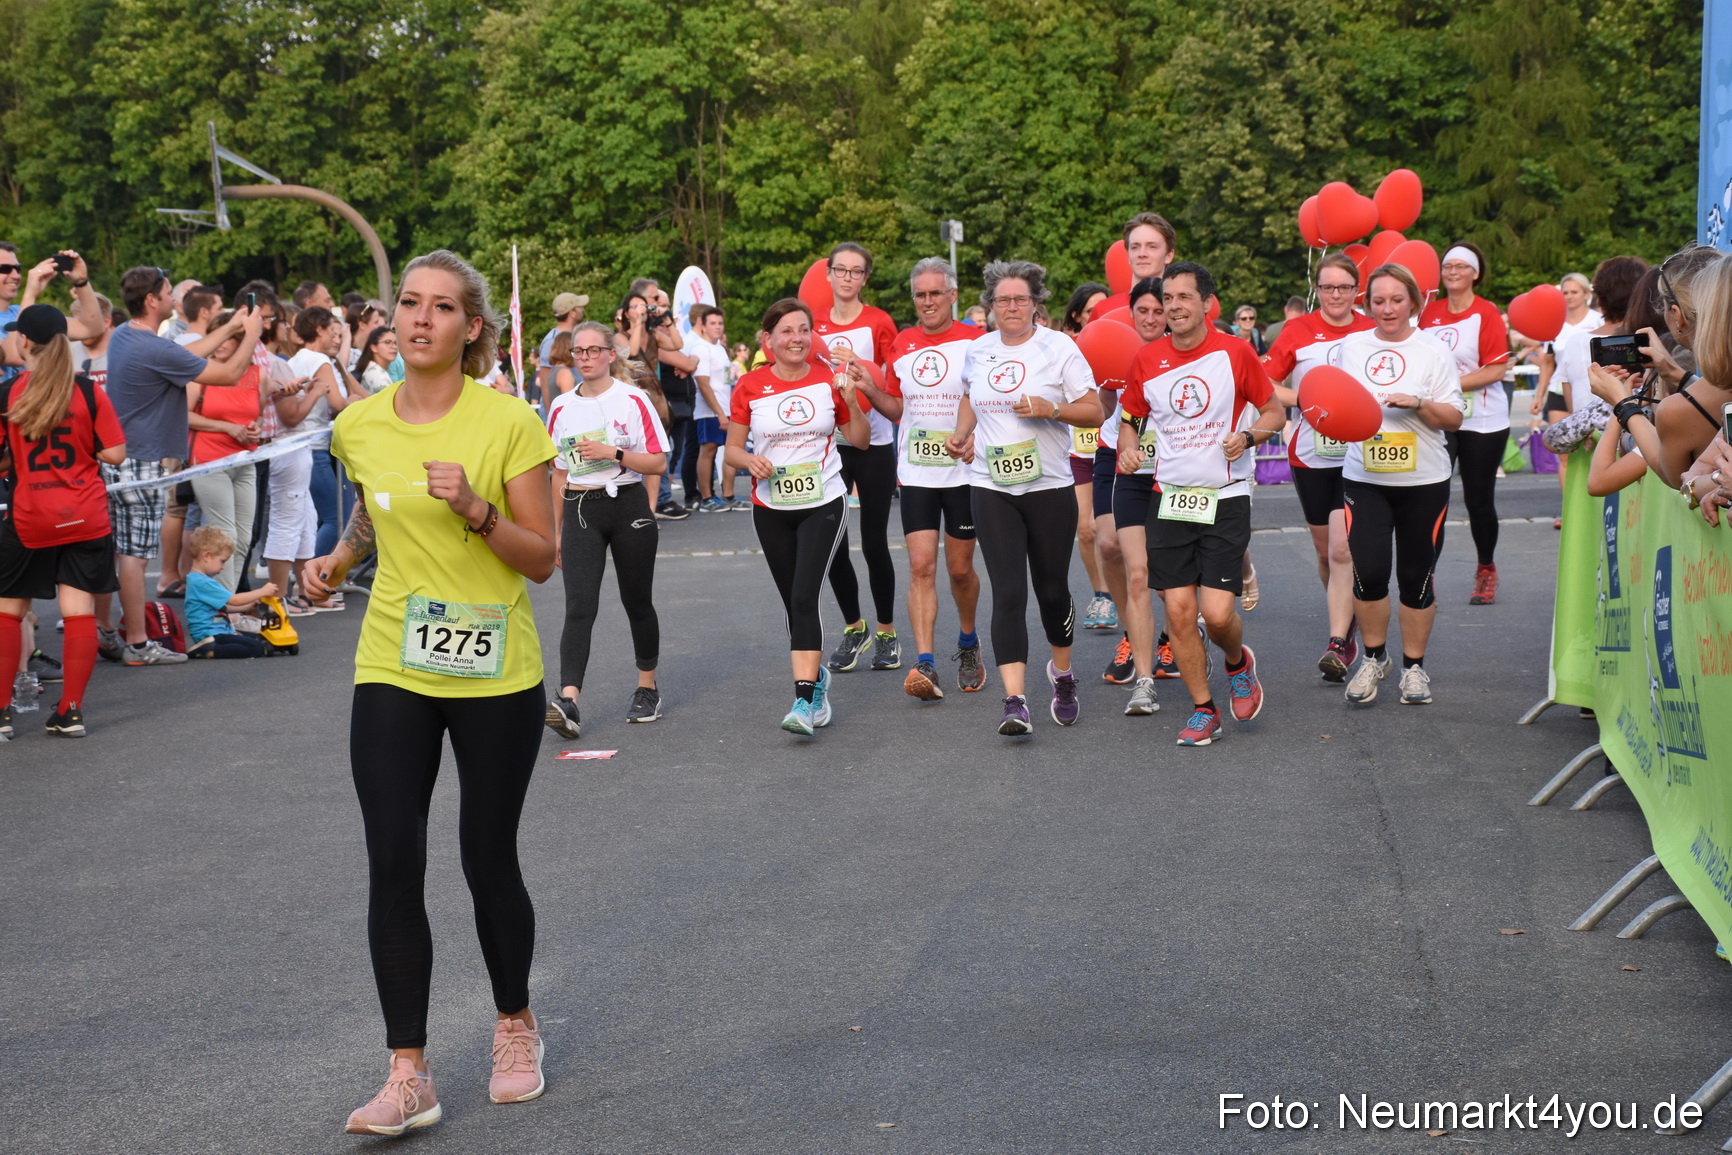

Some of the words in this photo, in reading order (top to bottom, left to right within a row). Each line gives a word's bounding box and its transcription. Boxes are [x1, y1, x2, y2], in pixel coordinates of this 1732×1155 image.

[942, 393, 961, 401] HERZ
[1205, 421, 1225, 430] HERZ
[25, 427, 76, 472] 25
[1369, 446, 1409, 461] 1898
[993, 454, 1034, 474] 1895
[775, 476, 815, 494] 1903
[1169, 493, 1209, 511] 1899
[419, 610, 461, 625] firmenlauf
[482, 623, 501, 631] 2019
[416, 624, 492, 657] 1275
[425, 660, 449, 669] Klinikum
[429, 652, 452, 663] Pollei
[453, 656, 474, 665] Anna
